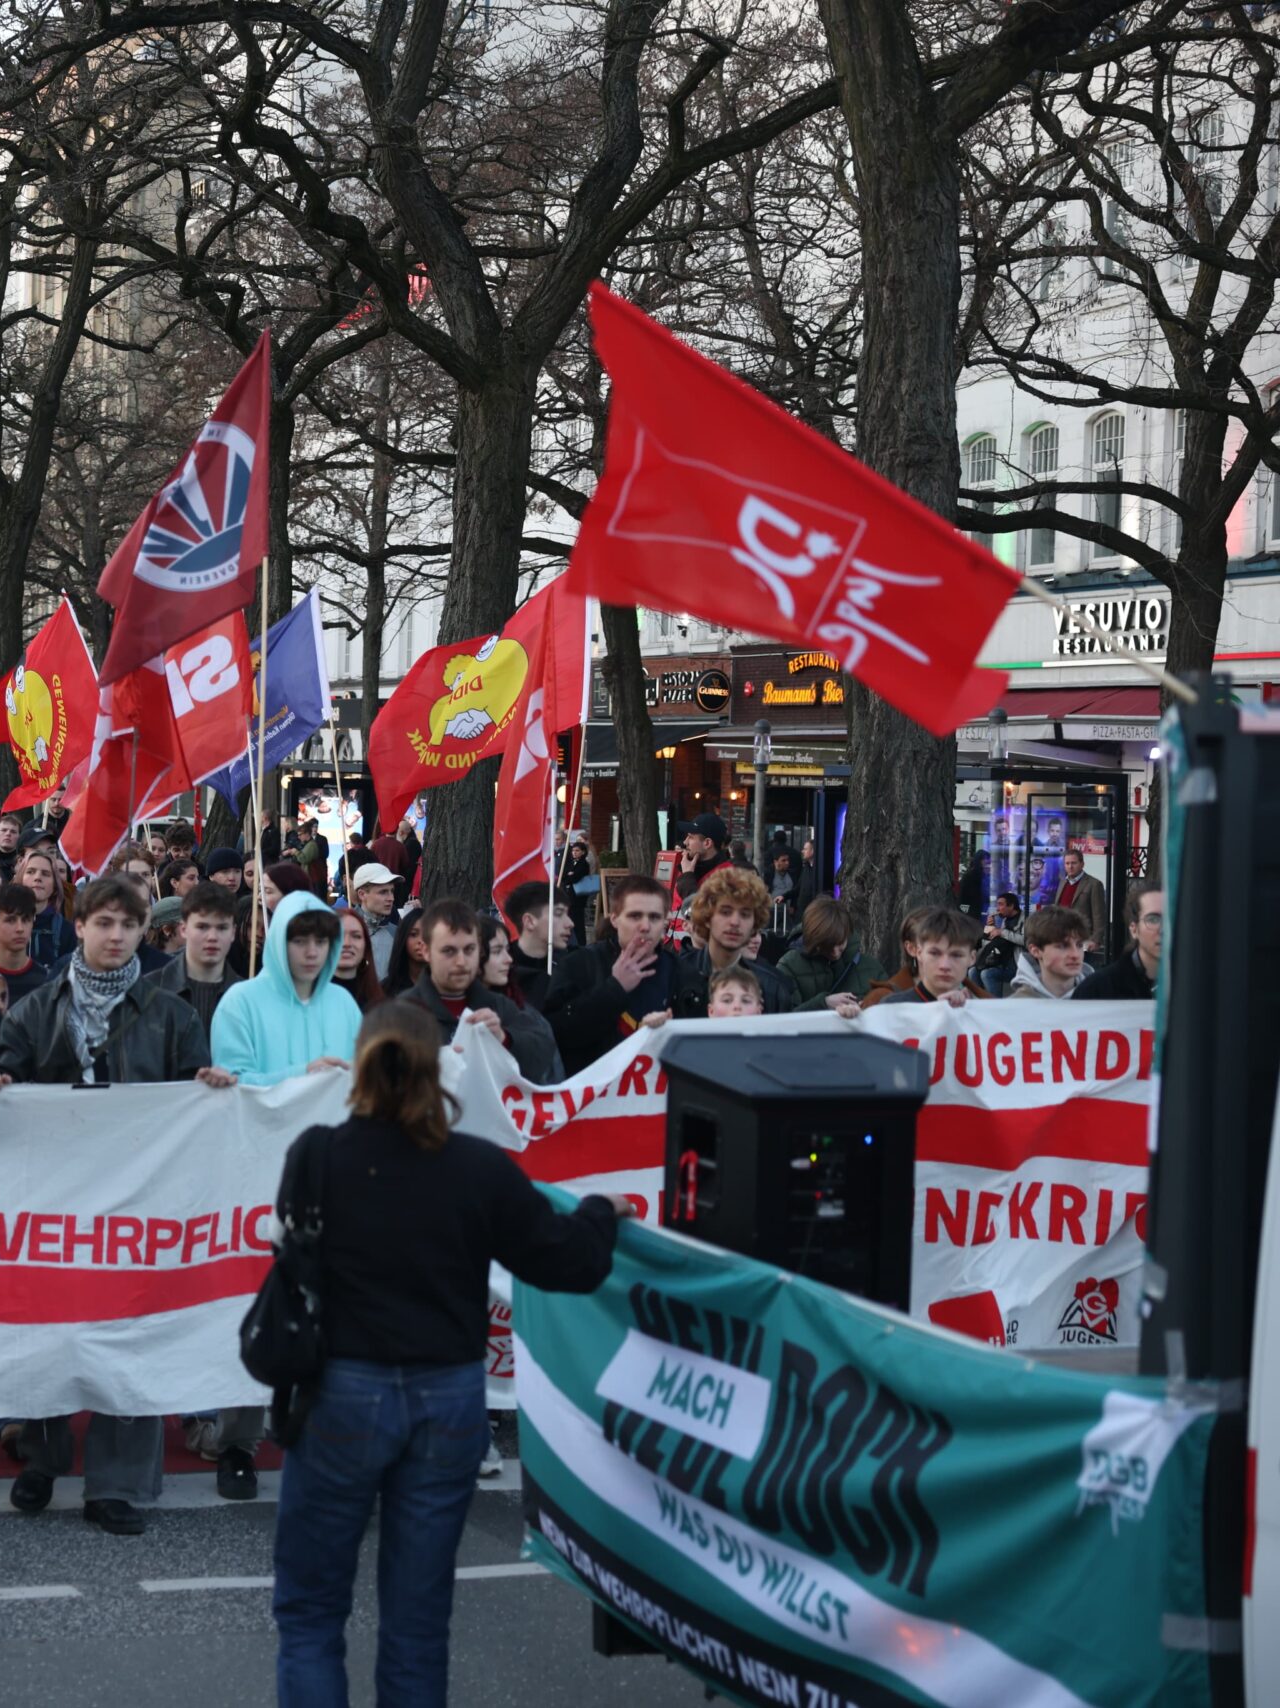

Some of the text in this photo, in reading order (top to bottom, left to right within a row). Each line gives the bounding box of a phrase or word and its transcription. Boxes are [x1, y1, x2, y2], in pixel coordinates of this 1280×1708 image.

[1052, 598, 1162, 635] VESUVIO
[1052, 634, 1161, 654] RESTAURANT
[699, 686, 729, 697] GUINNESS
[762, 681, 816, 704] Baumann's
[646, 1356, 736, 1429] MACH
[653, 1481, 851, 1641] WAS DU WILLST
[595, 1562, 736, 1677] WEHRPFLICHT!
[738, 1652, 802, 1708] NEIN
